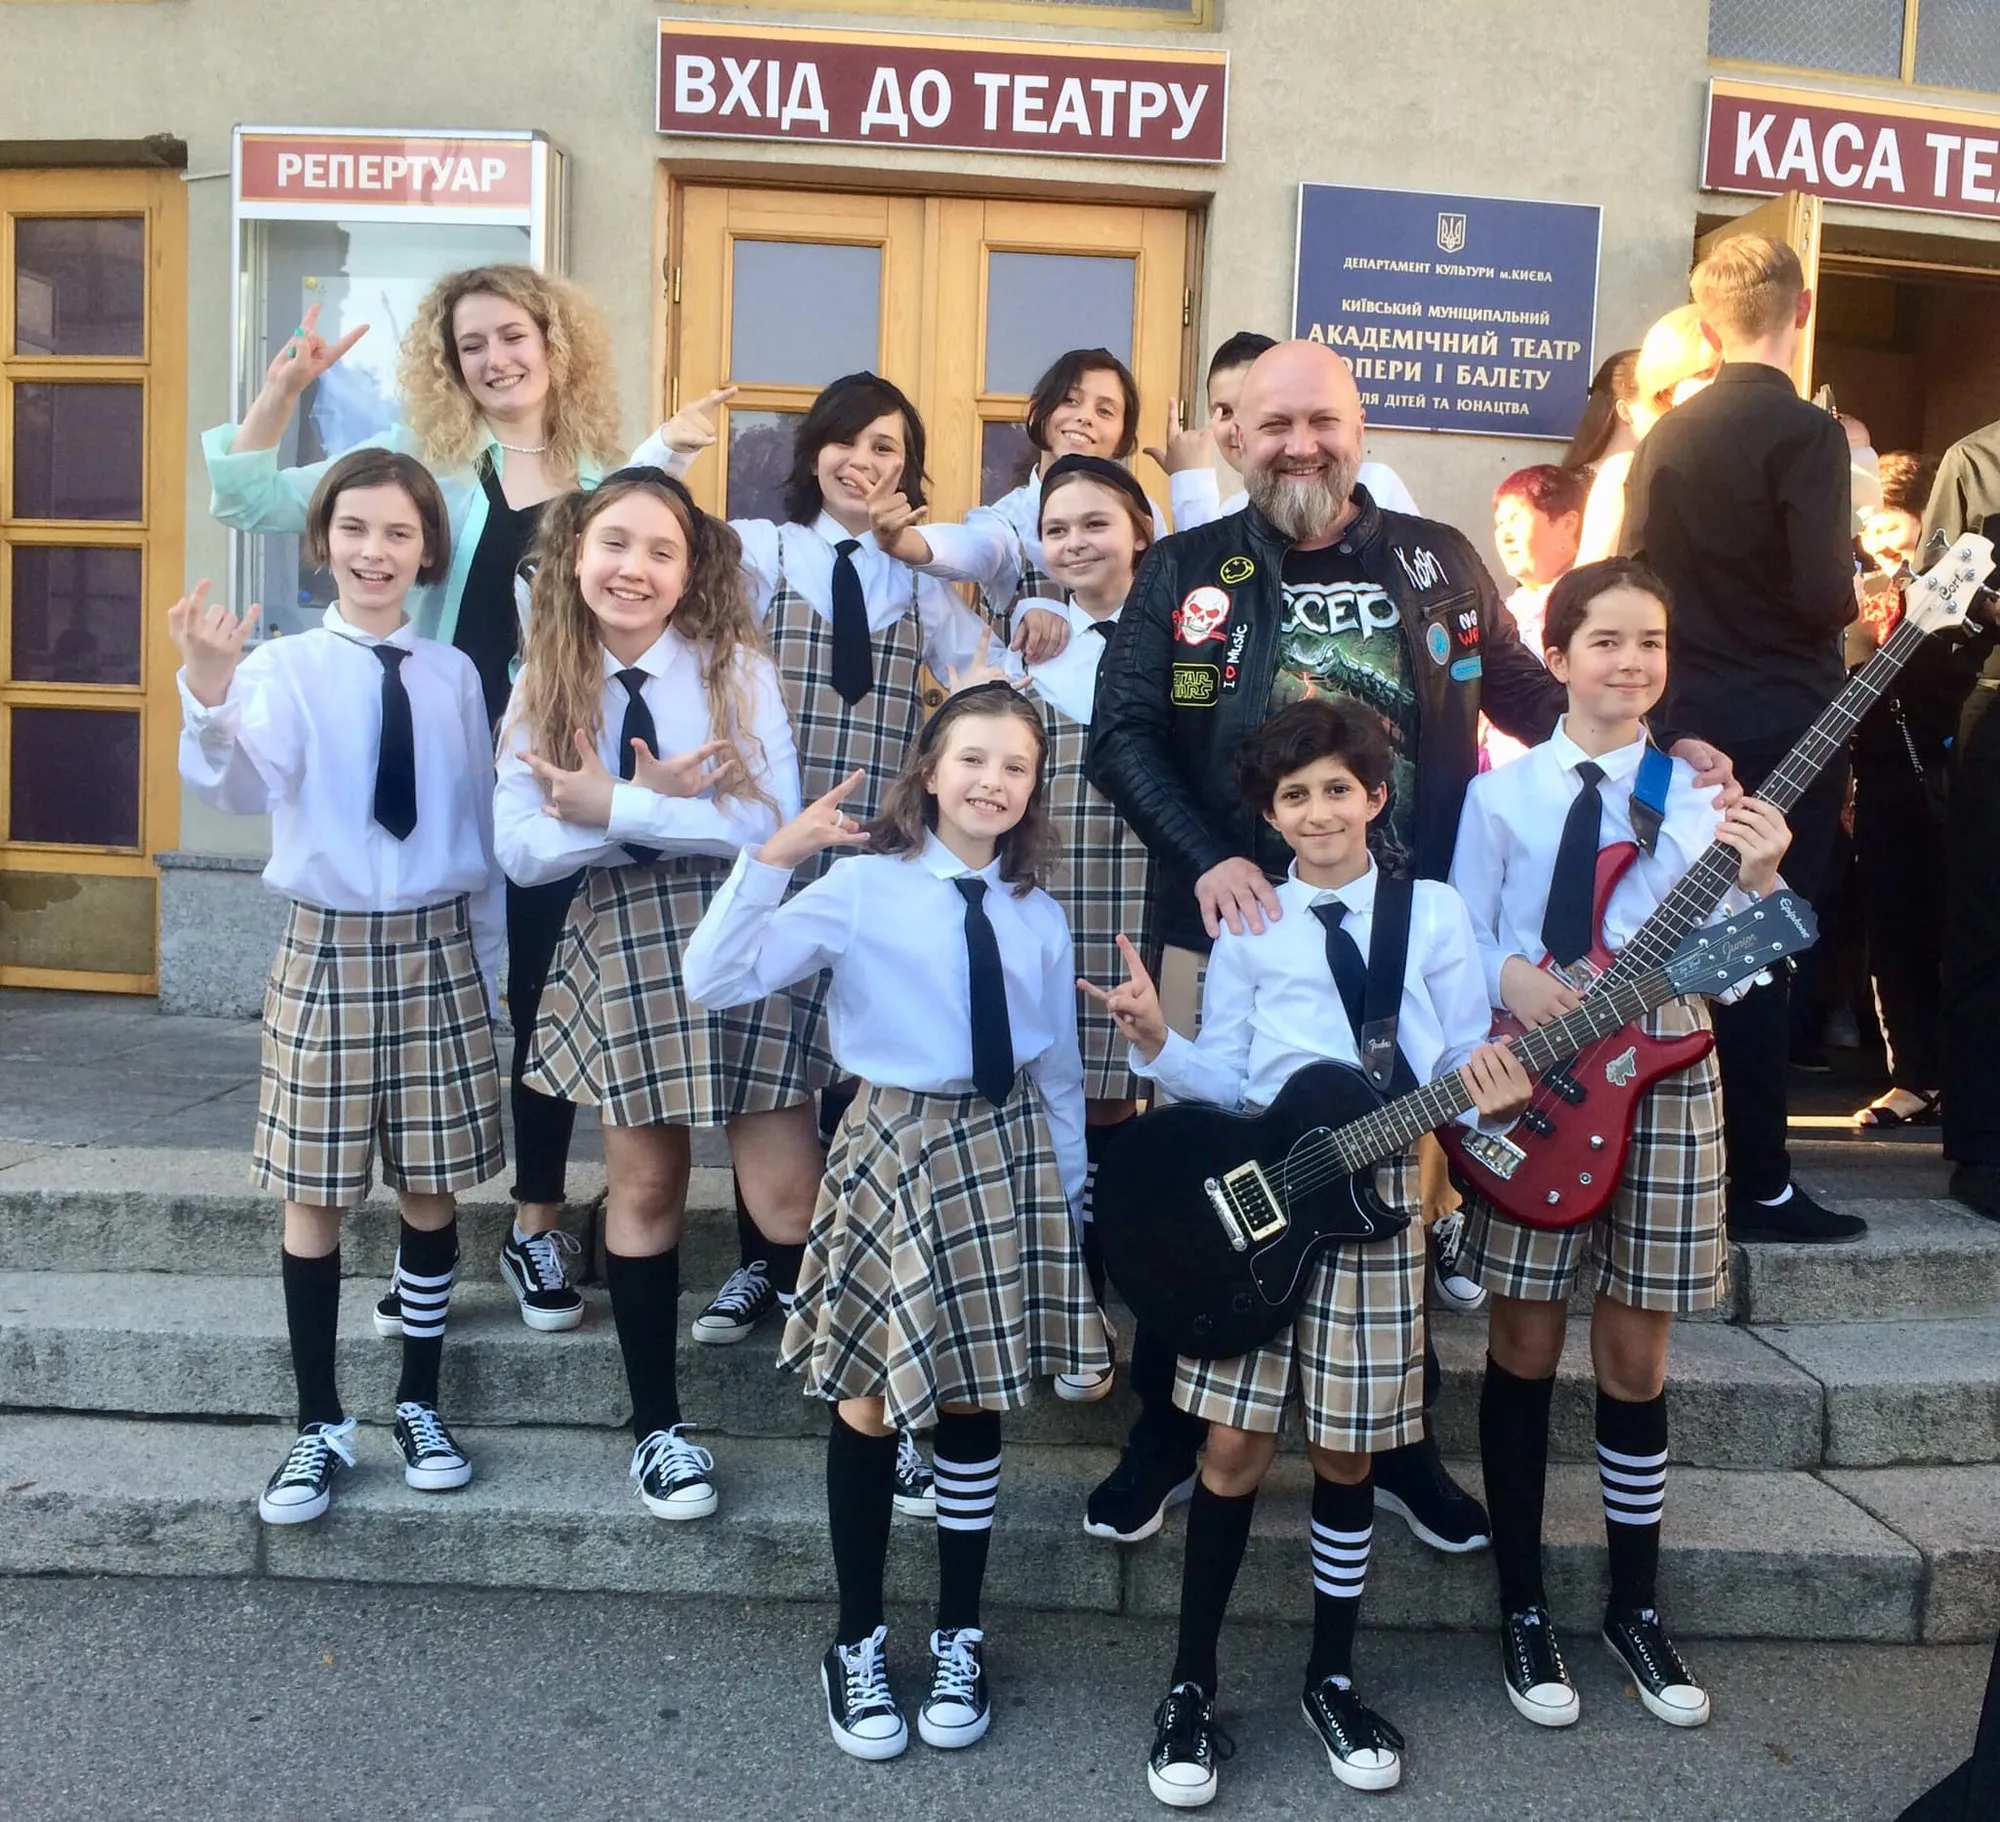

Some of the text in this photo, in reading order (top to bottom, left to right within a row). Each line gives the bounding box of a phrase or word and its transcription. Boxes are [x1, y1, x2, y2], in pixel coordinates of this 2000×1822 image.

[674, 54, 1209, 140] ВХІД ДО ТЕАТРУ
[277, 152, 507, 193] РЕПЕРТУАР
[1734, 110, 2000, 204] КАСА ТЕ
[1343, 256, 1431, 275] ДЕПАРТАМЕНТ
[1435, 263, 1495, 279] КУЛЬТУРИ
[1341, 298, 1551, 326] КИЇВСЬКИЙ МУНІЦИПАЛЬНИЙ
[1307, 322, 1582, 362] АКАДЕМІЧНИЙ ТЕАТР
[1435, 362, 1443, 384] І
[1456, 364, 1552, 391] БАЛЕТУ
[1358, 391, 1530, 416] ЛЯ ДІТЕЙ ТА ЮНАЦТВА
[1458, 609, 1478, 631] NO
[1226, 623, 1248, 664] Music
